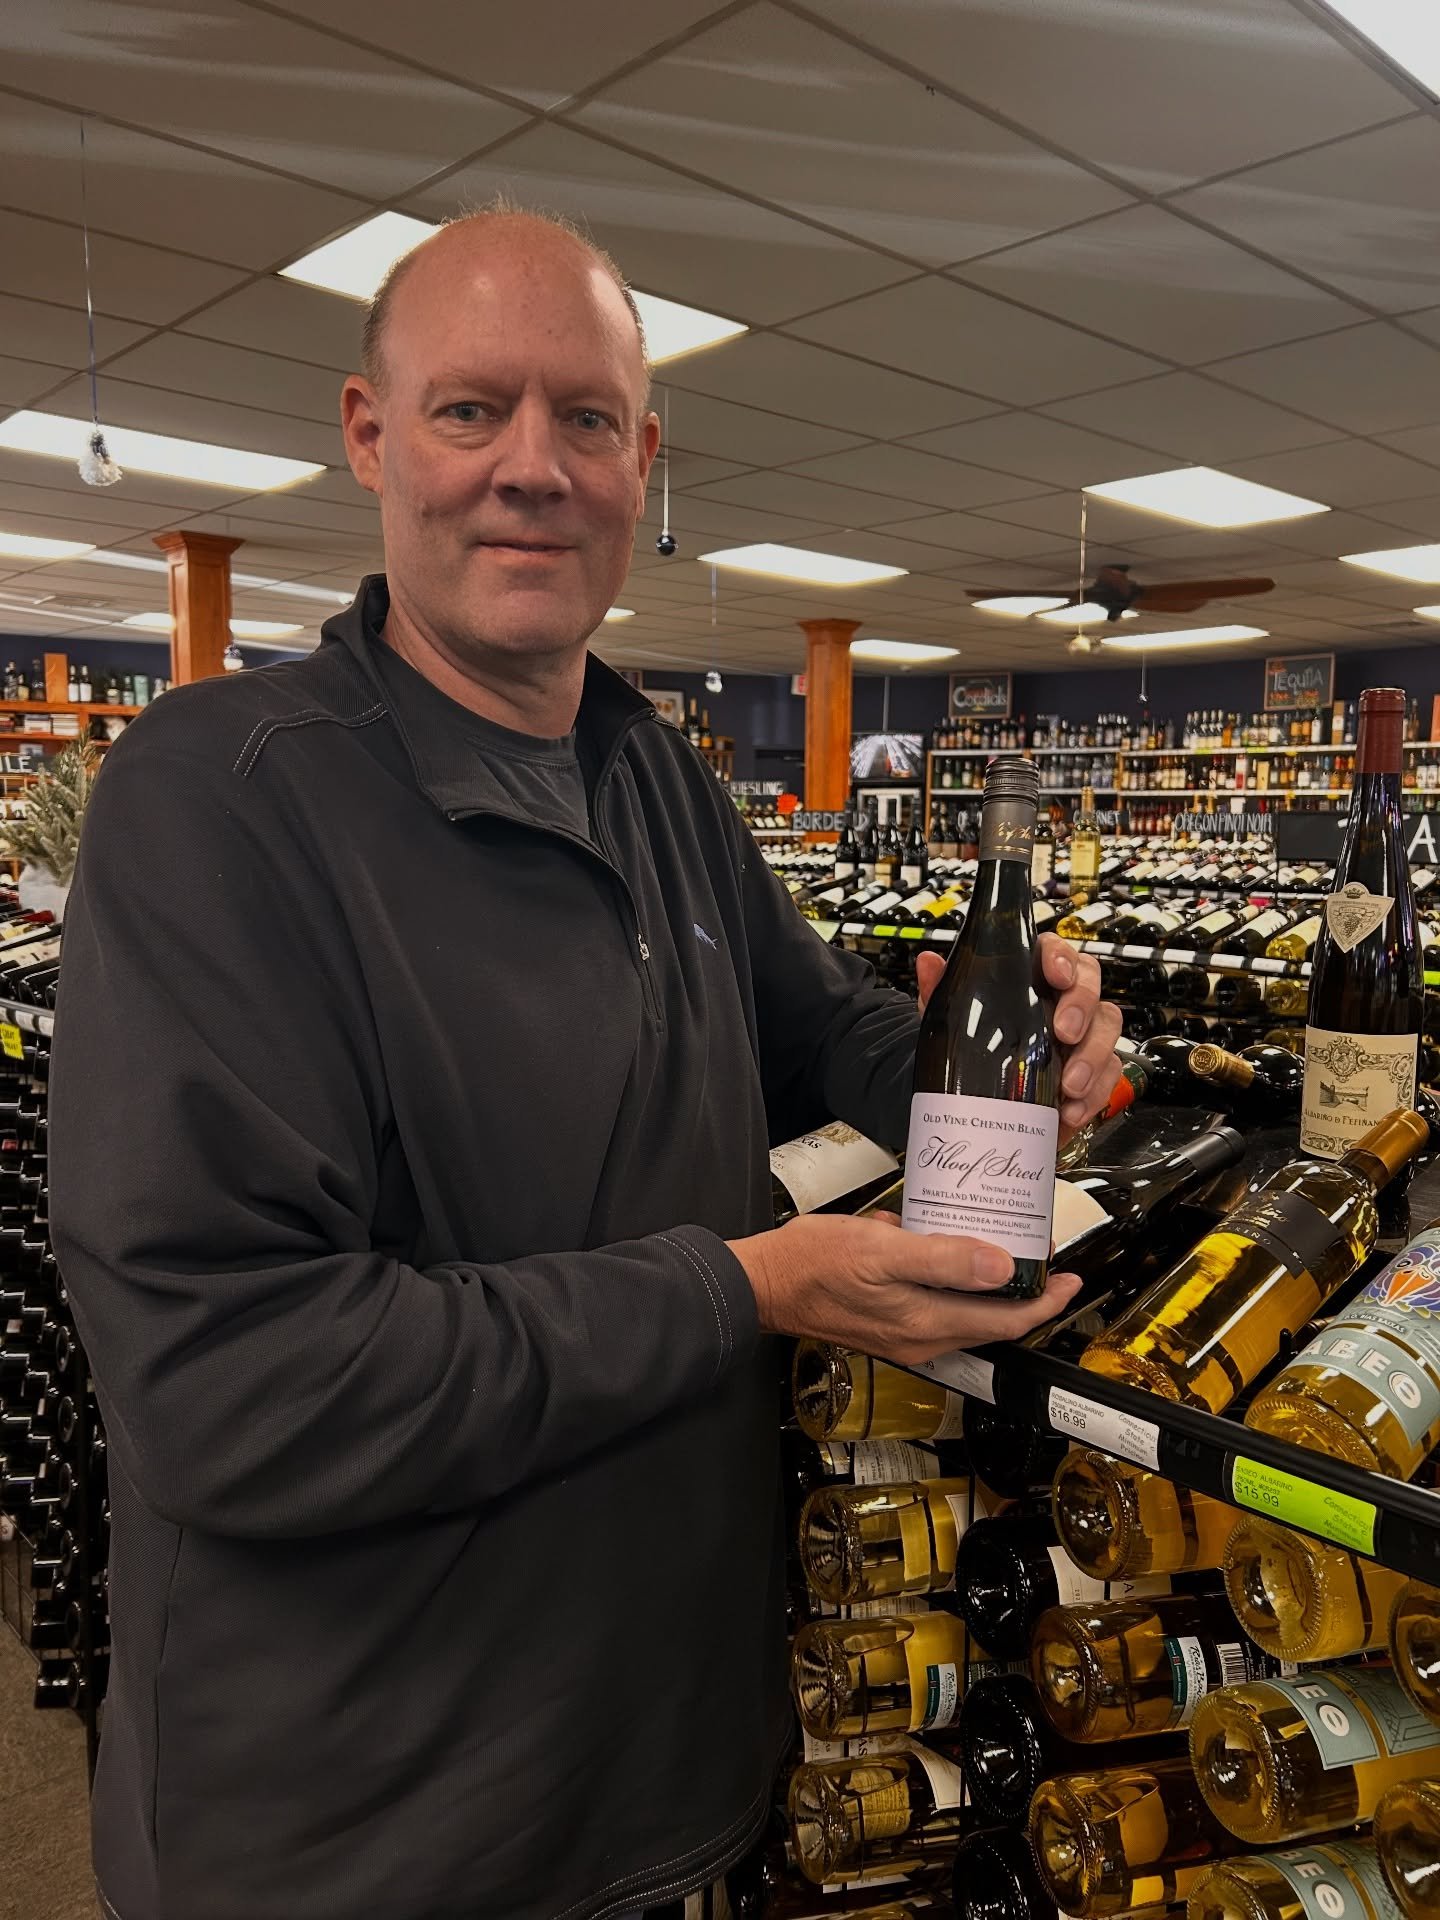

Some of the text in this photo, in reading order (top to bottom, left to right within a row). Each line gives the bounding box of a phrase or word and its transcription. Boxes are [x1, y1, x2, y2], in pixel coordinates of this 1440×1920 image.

[953, 684, 1007, 708] Cordials
[923, 1112, 1047, 1137] OLD VINE CHENIN BLANC
[917, 1135, 1046, 1189] Kloof Street
[921, 1187, 1036, 1210] SWARTLAND WINE OF ORIGIN
[981, 1183, 1032, 1198] VINTAGE 2024
[921, 1209, 930, 1217] BY
[930, 1209, 951, 1220] CHRIS
[951, 1213, 958, 1221] &
[958, 1213, 991, 1226] ANDREA
[992, 1218, 1032, 1231] MULLINEUX
[1050, 1406, 1086, 1429] $16.99
[1124, 1428, 1145, 1446] State
[1234, 1481, 1280, 1508] $15.99
